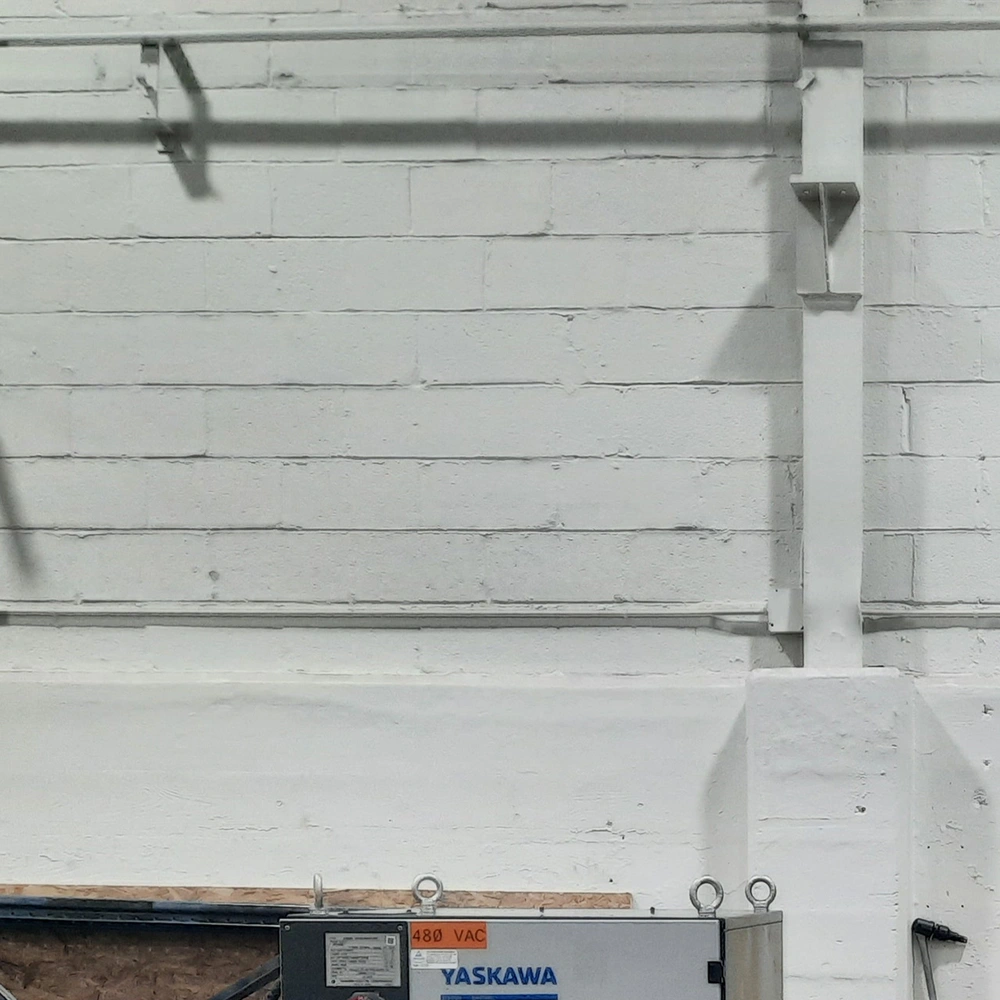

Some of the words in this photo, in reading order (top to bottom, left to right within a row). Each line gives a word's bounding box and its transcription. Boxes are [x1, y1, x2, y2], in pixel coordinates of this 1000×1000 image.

[411, 929, 443, 943] 480
[453, 929, 486, 943] VAC
[441, 966, 558, 986] YASKAWA
